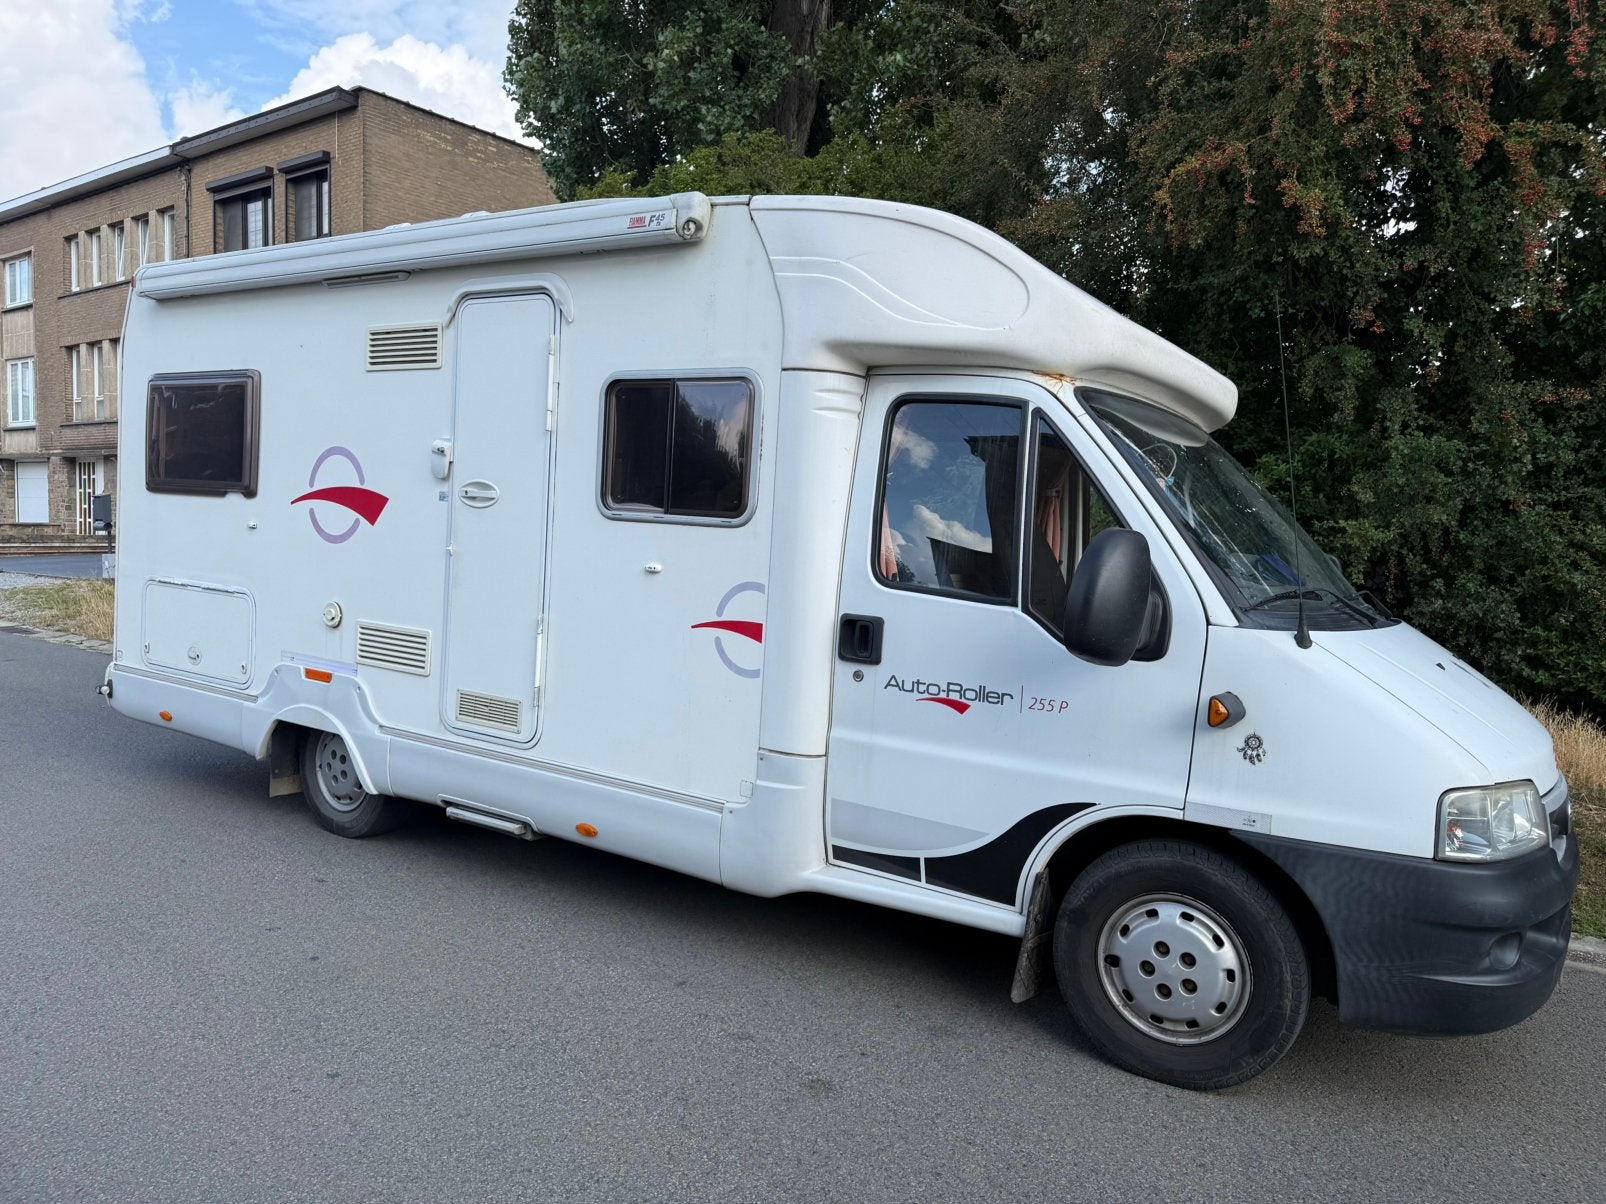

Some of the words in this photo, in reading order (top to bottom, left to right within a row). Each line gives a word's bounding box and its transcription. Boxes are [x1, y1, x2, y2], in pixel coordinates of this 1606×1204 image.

[884, 674, 1014, 706] Auto-Roller
[1028, 696, 1056, 712] 255
[1058, 700, 1070, 714] P
